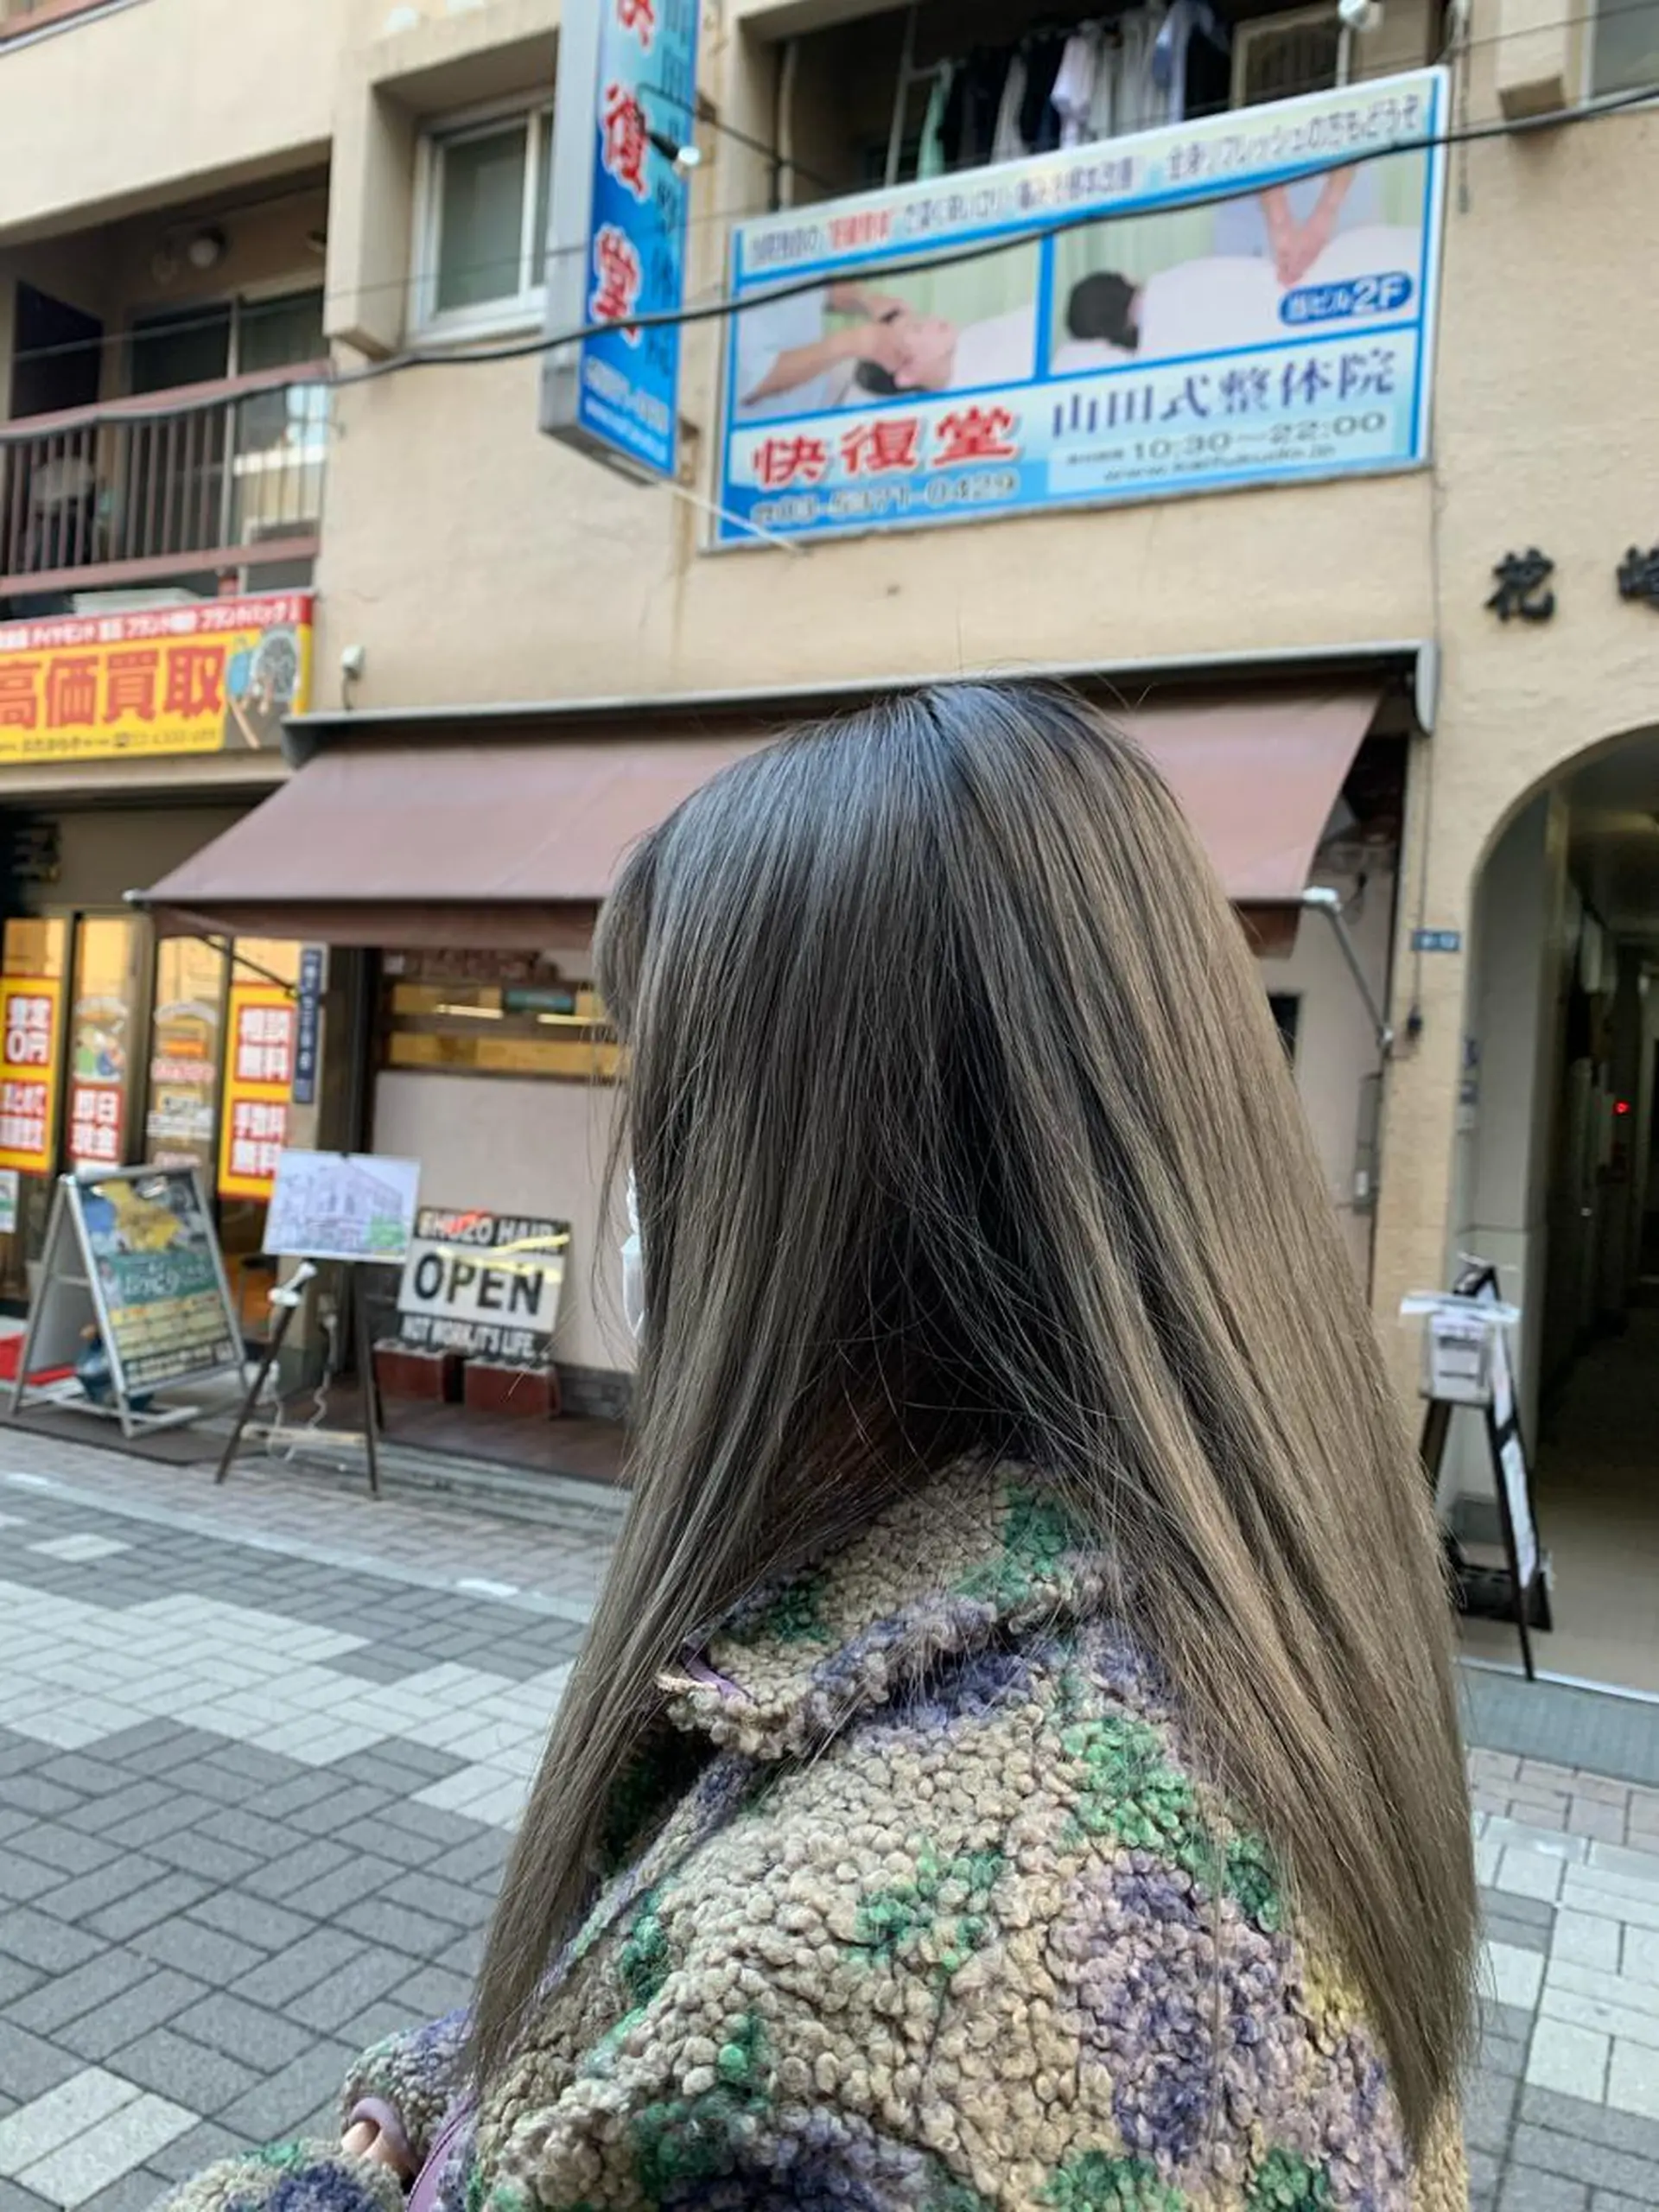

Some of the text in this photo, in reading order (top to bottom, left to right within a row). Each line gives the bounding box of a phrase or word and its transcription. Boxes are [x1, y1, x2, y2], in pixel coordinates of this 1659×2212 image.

[1052, 348, 1395, 438] 山田式整体院
[753, 406, 1018, 486] 快復堂
[0, 646, 226, 729] 高価買取
[415, 1251, 544, 1316] OPEN
